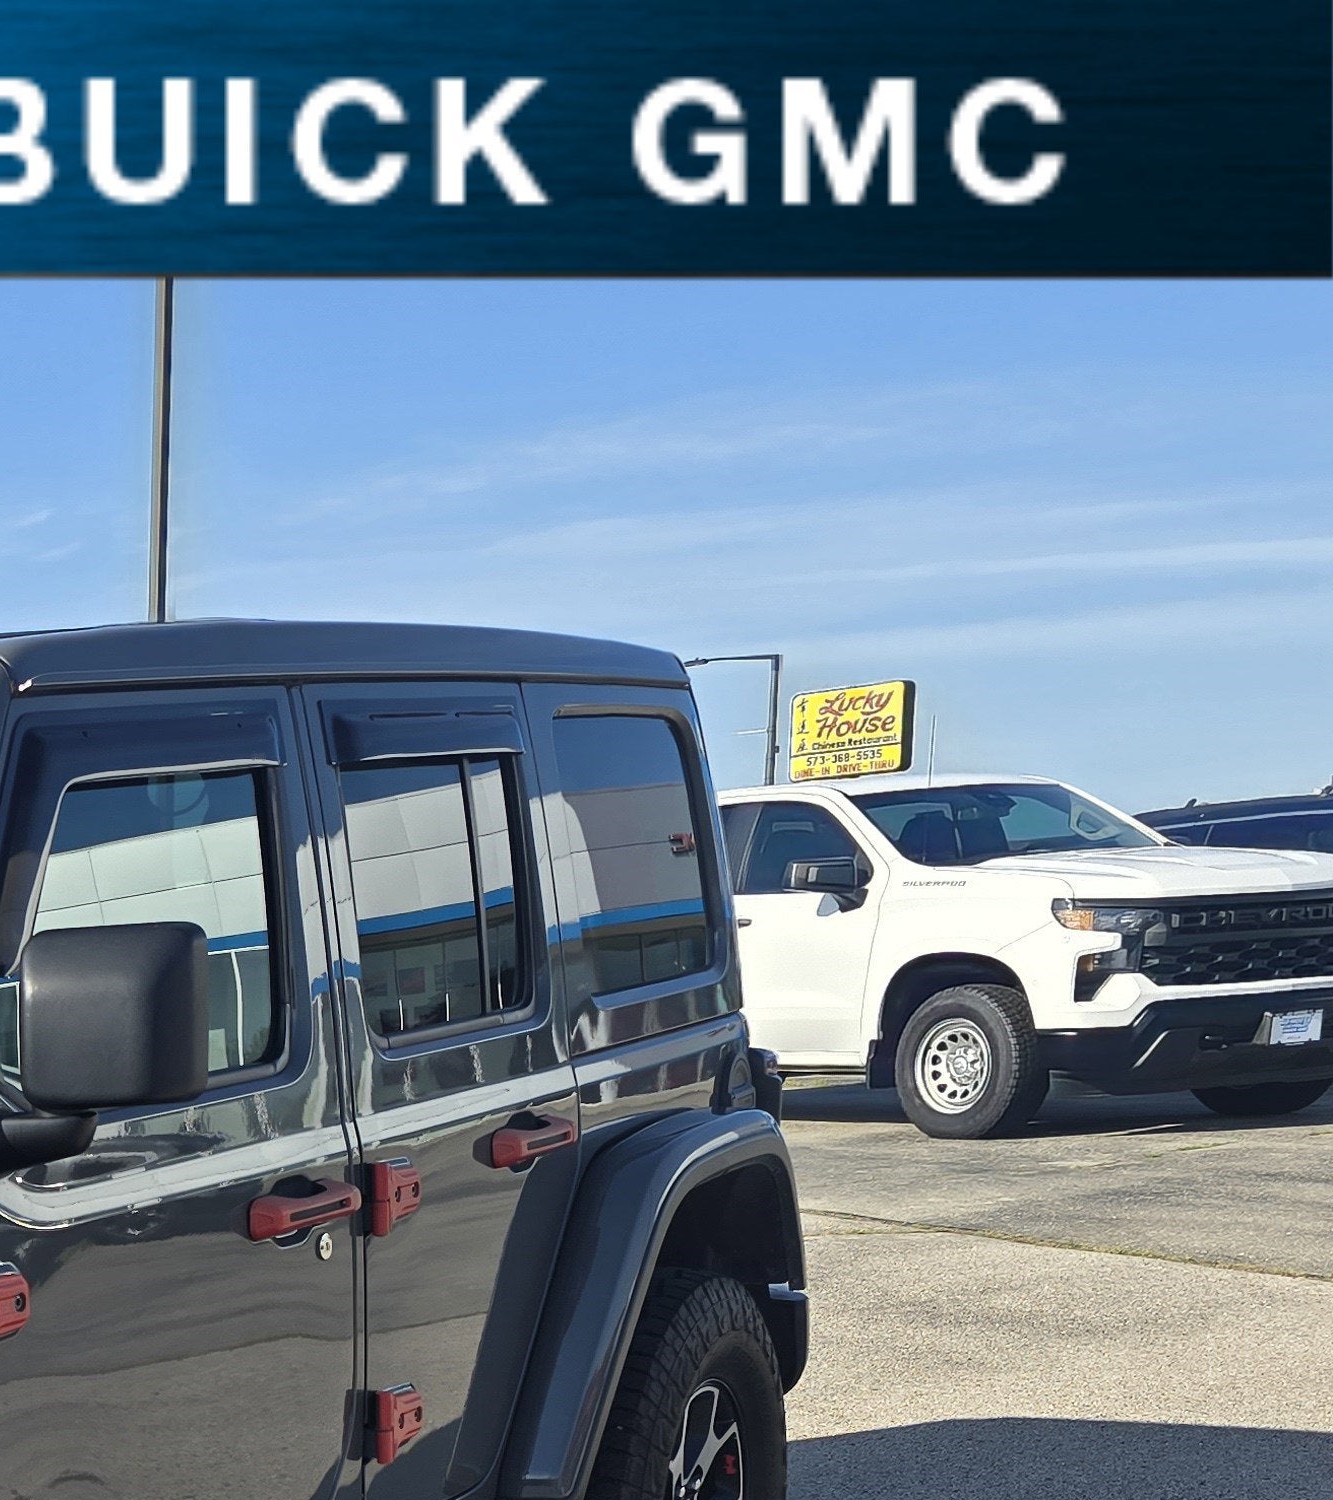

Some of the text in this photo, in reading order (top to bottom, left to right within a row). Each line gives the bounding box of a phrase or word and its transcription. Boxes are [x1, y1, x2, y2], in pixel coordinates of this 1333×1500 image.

[818, 690, 895, 717] Lucky
[815, 715, 896, 739] House
[812, 733, 897, 751] Chinese Restaurant
[1171, 903, 1333, 928] CHEVRO
